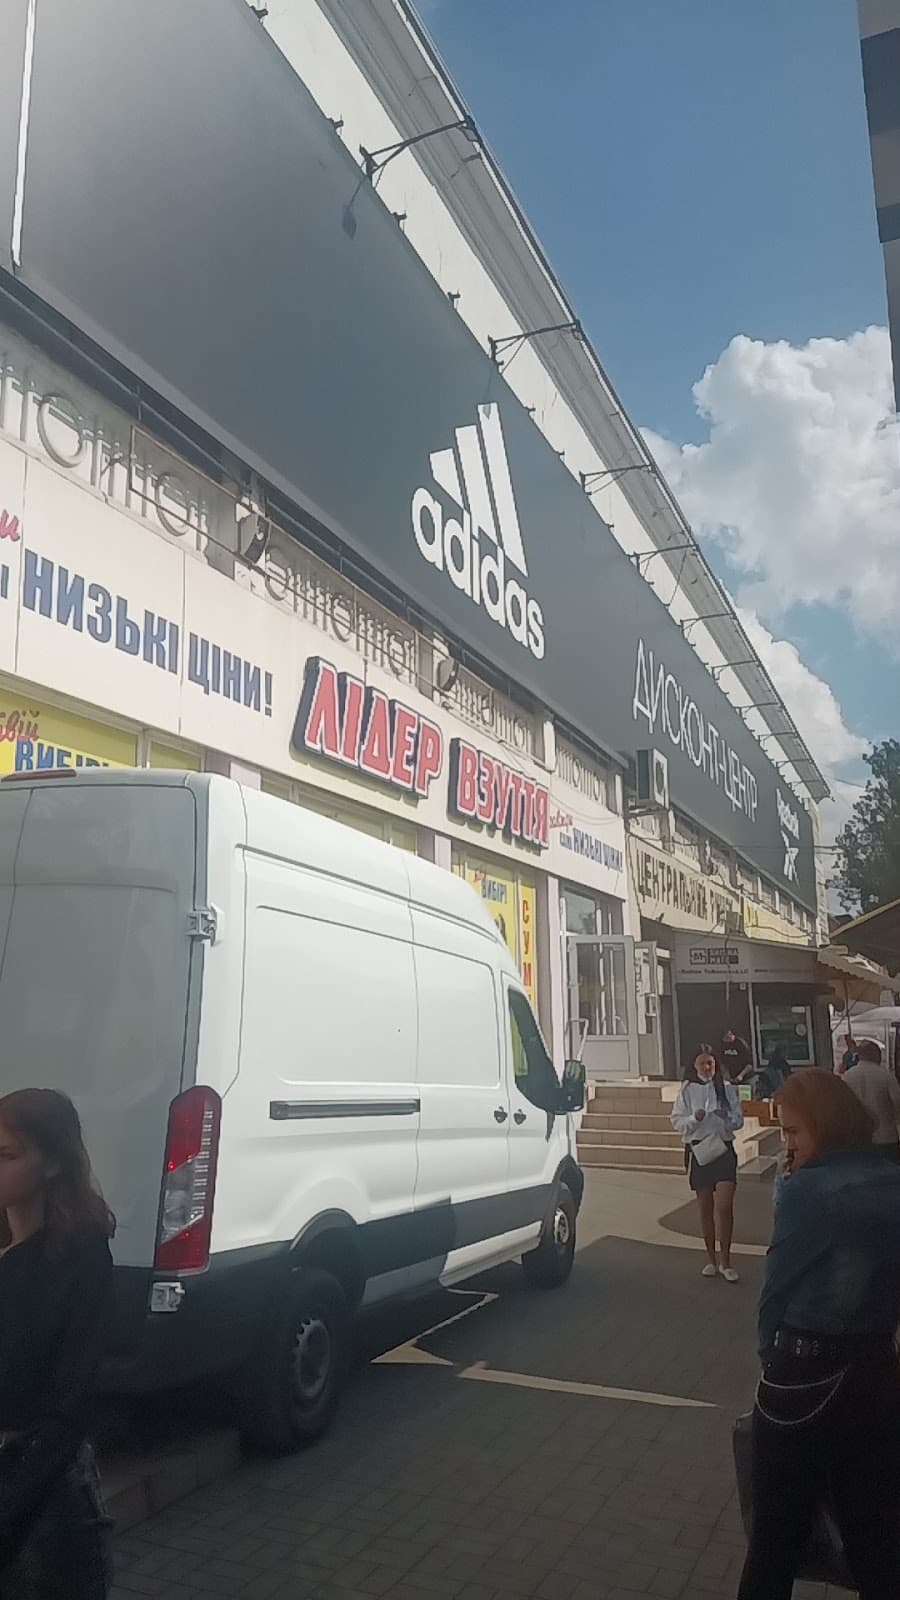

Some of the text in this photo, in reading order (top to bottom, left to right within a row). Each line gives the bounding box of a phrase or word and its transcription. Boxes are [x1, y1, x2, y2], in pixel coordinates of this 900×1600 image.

[23, 548, 274, 717] НИЗЬКІ ЦІНИ!
[411, 487, 546, 660] adidas
[303, 663, 550, 847] ЛІДЕР ВЗУТТЯ
[632, 638, 758, 822] ДИСКОНТ-ЦЕНТР
